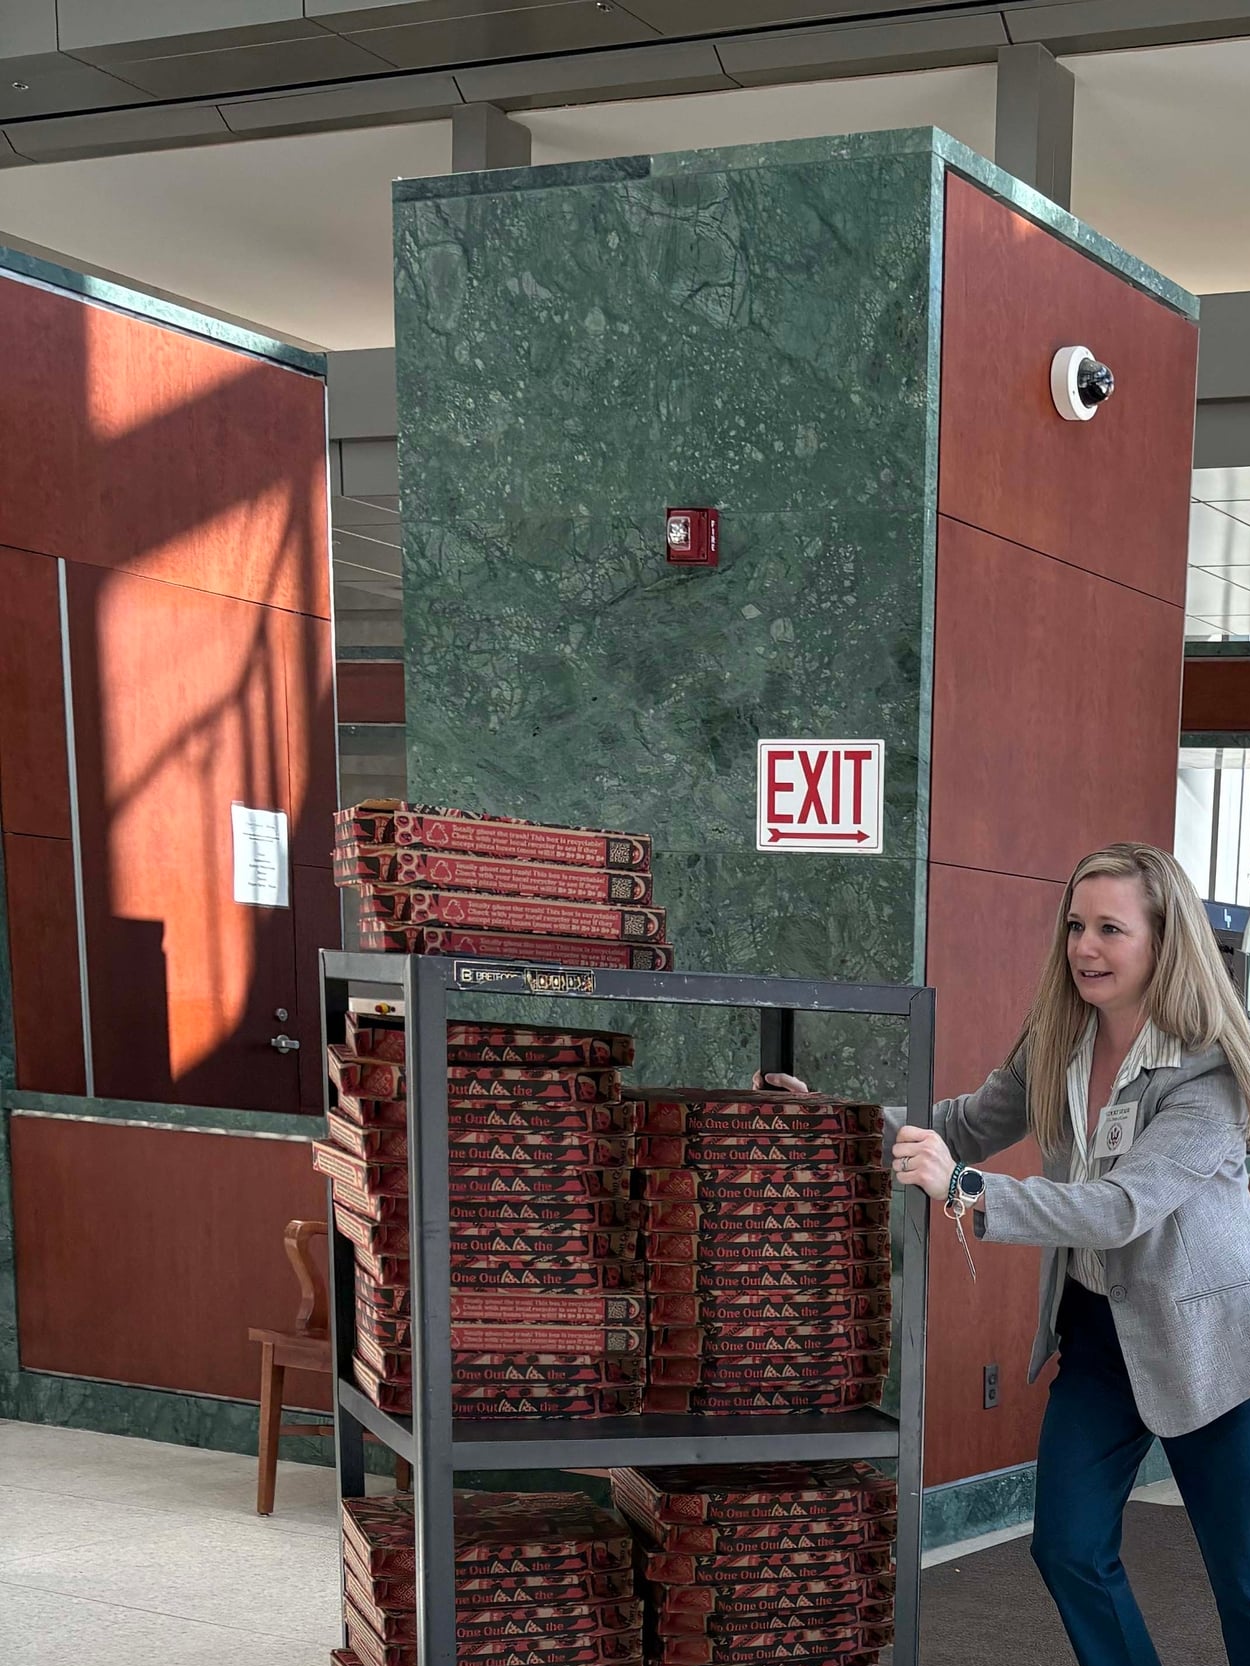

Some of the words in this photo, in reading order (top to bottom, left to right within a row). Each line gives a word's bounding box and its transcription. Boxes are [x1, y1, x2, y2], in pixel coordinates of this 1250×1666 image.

[766, 750, 872, 825] EXIT
[476, 971, 518, 981] BRETFO
[448, 1085, 469, 1095] Out
[513, 1085, 532, 1096] the
[705, 1118, 728, 1129] One
[792, 1120, 809, 1129] the
[448, 1148, 465, 1159] ne
[468, 1148, 491, 1159] Out
[533, 1150, 553, 1160] the
[704, 1150, 726, 1160] One
[729, 1150, 750, 1160] Out
[789, 1150, 806, 1160] the
[718, 1188, 741, 1198] One
[743, 1187, 764, 1197] Out
[803, 1188, 820, 1197] the
[451, 1207, 476, 1218] One
[478, 1207, 501, 1218] Out
[541, 1208, 560, 1219] the
[703, 1219, 717, 1229] No
[720, 1219, 742, 1229] One
[745, 1219, 766, 1229] Out
[803, 1218, 820, 1227] the
[449, 1240, 468, 1250] ne
[470, 1240, 493, 1250] Out
[534, 1241, 552, 1251] the
[717, 1247, 739, 1258] One
[742, 1246, 763, 1257] Out
[800, 1246, 817, 1256] the
[451, 1272, 476, 1283] One
[480, 1272, 502, 1283] Out
[543, 1274, 562, 1284] the
[716, 1276, 739, 1286] One
[741, 1276, 762, 1286] Out
[800, 1275, 817, 1285] the
[717, 1308, 740, 1318] One
[743, 1307, 763, 1318] Out
[801, 1307, 818, 1317] the
[721, 1340, 743, 1351] One
[746, 1340, 767, 1350] Out
[804, 1339, 821, 1349] the
[457, 1369, 481, 1380] One
[484, 1369, 506, 1379] Out
[547, 1369, 565, 1380] the
[727, 1508, 749, 1518] One
[752, 1508, 772, 1517] Out
[809, 1505, 827, 1514] the
[715, 1570, 738, 1580] One
[740, 1570, 760, 1579] Out
[800, 1568, 817, 1576] the
[456, 1628, 481, 1638] One
[484, 1626, 506, 1636] Out
[546, 1622, 564, 1632] the
